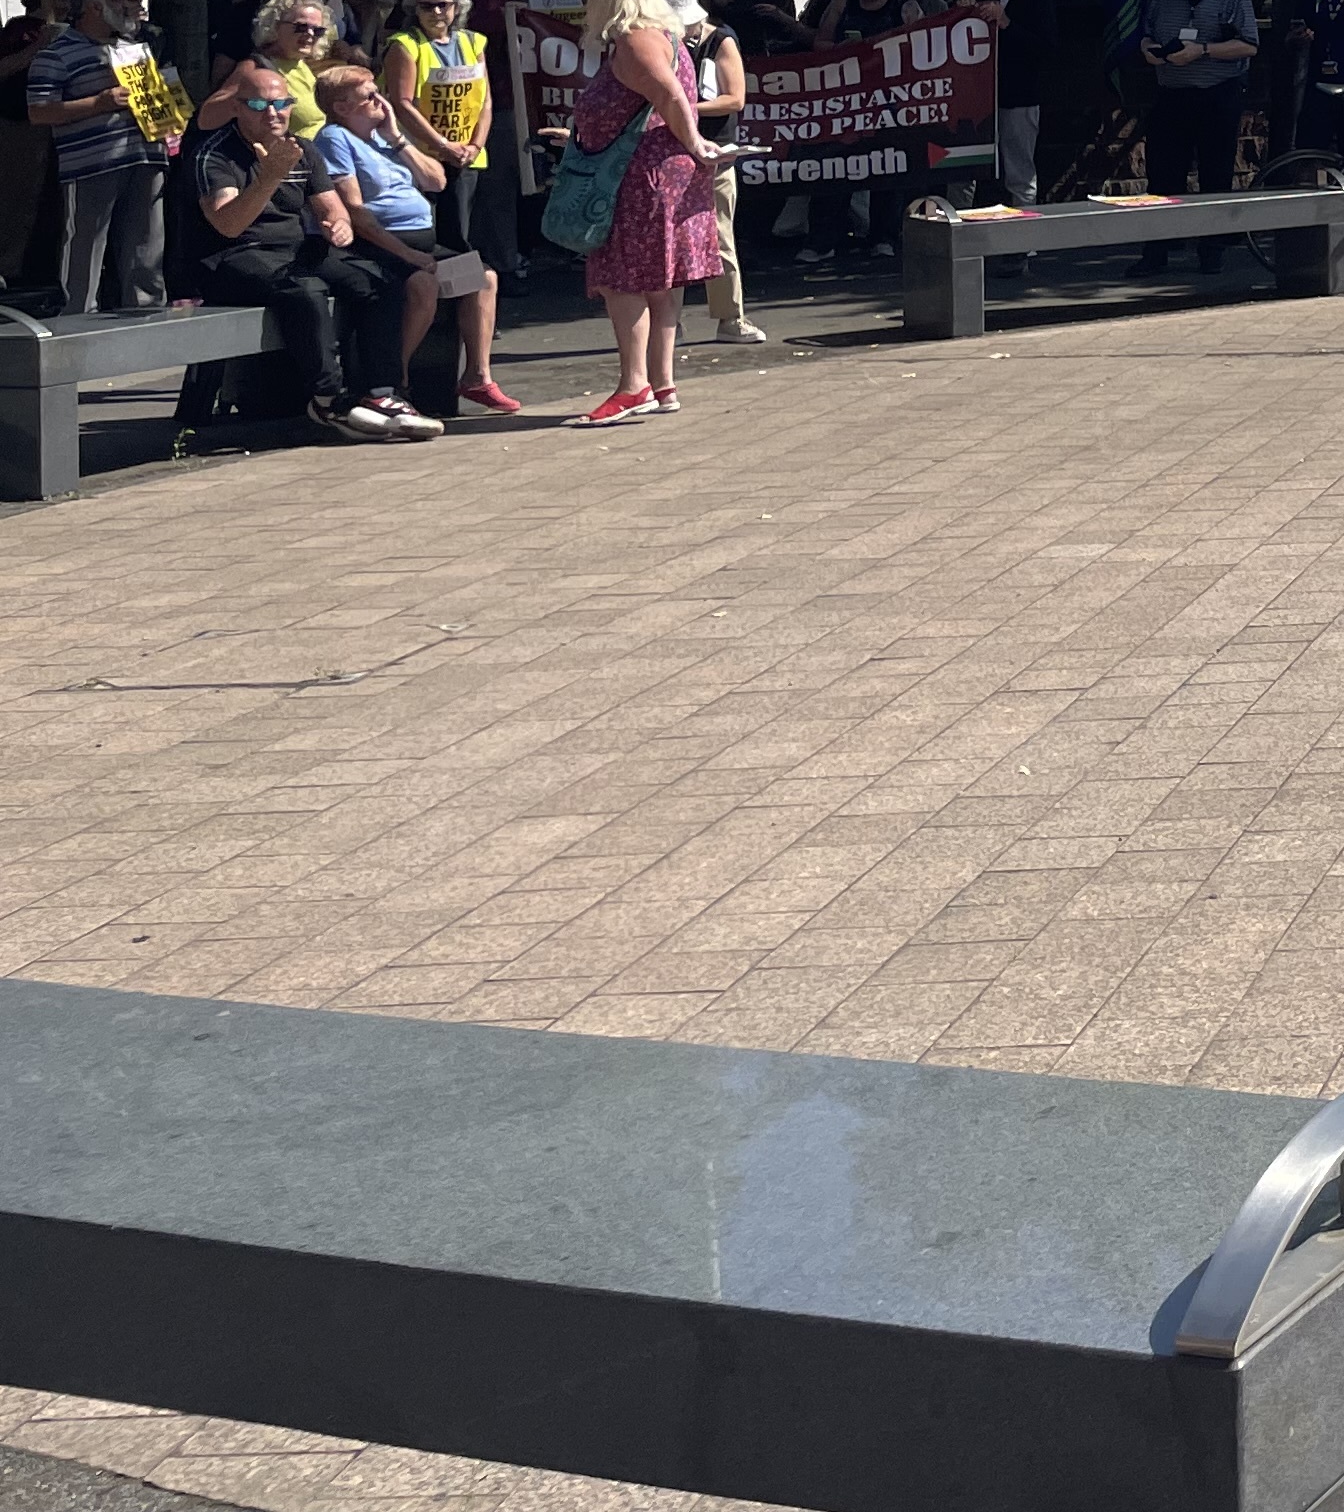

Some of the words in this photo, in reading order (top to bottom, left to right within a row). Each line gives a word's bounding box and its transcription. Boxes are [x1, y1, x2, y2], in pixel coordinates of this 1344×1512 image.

[874, 17, 992, 79] TUC
[121, 61, 149, 80] STOP
[431, 82, 472, 99] STOP
[743, 77, 954, 122] RESISTANCE
[430, 99, 462, 114] THE
[429, 114, 460, 129] FAR
[773, 121, 822, 143] NO
[831, 102, 950, 136] PEACE!
[437, 126, 472, 143] IGHT
[741, 147, 908, 186] Strength
